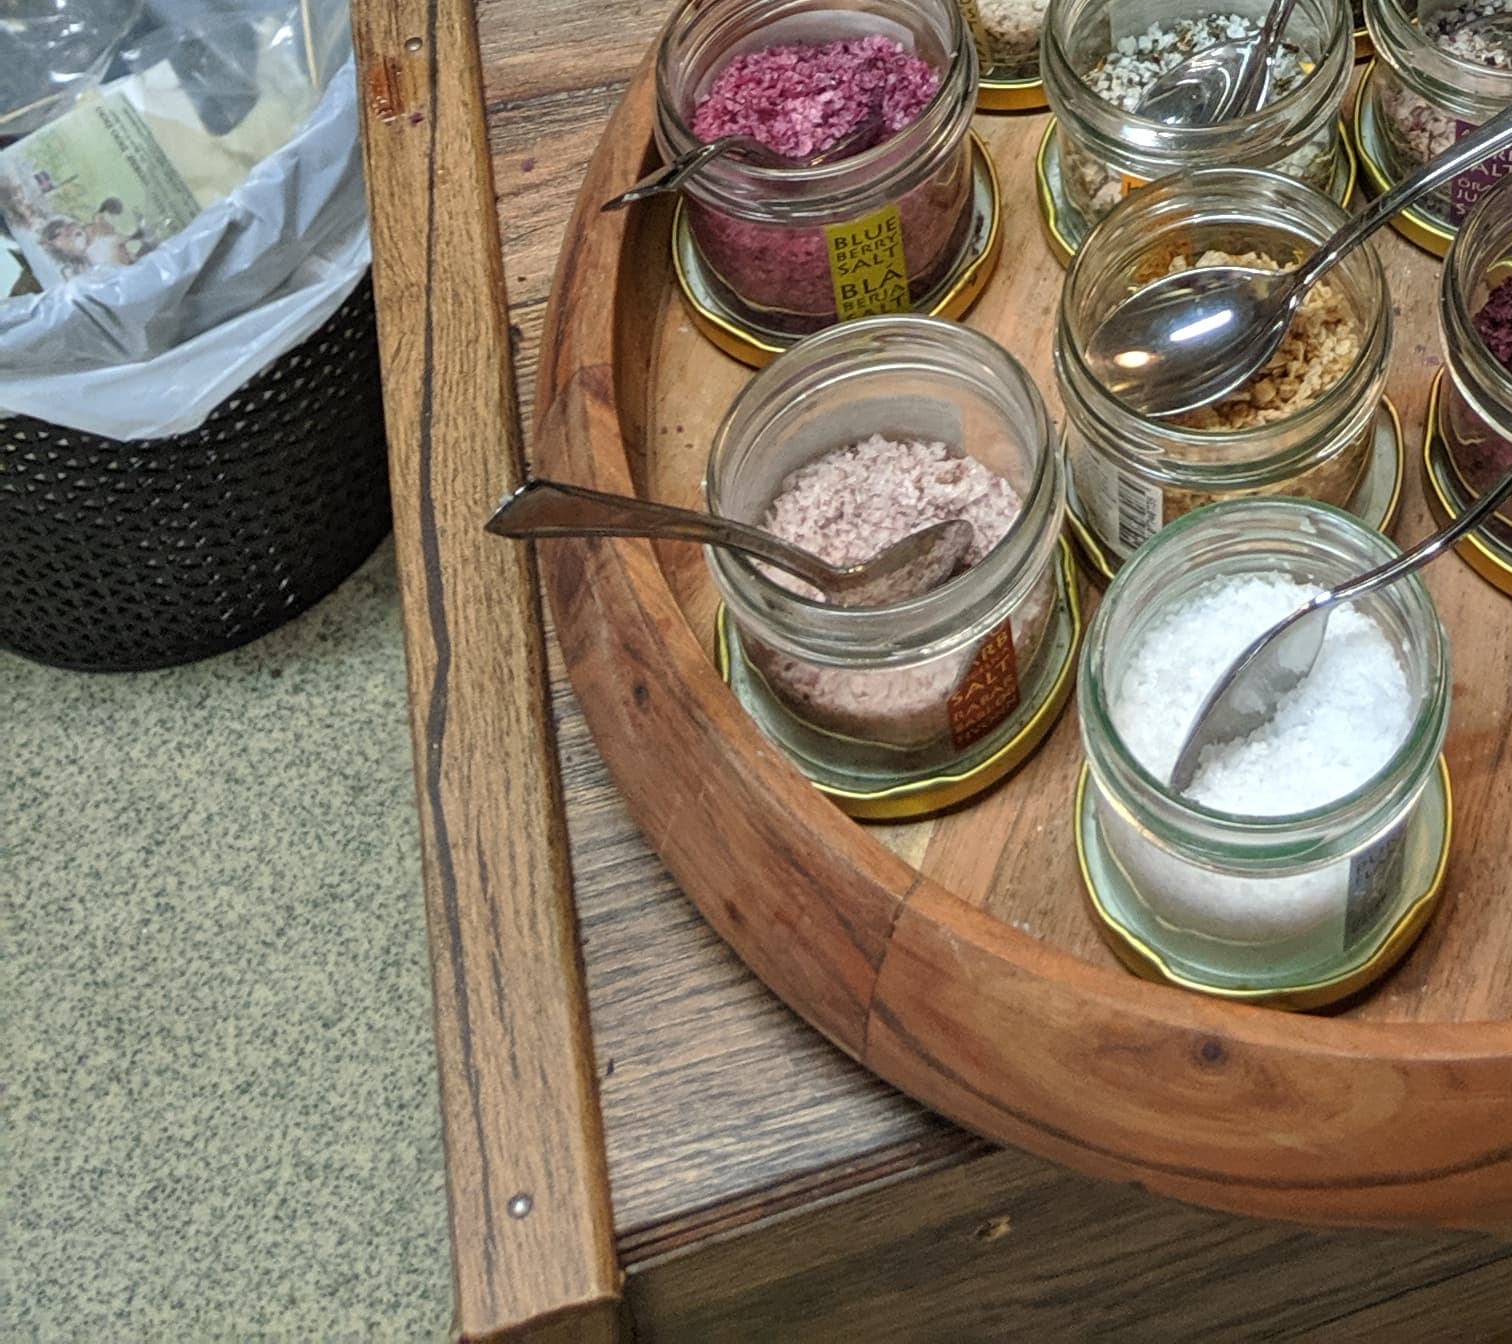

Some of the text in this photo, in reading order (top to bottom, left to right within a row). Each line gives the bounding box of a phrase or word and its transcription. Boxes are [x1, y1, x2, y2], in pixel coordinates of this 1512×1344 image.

[835, 216, 896, 250] BLUE
[837, 231, 897, 262] BERRY
[838, 243, 898, 276] SALT
[841, 263, 902, 300] BLÁ
[843, 284, 905, 312] BERJA
[951, 655, 1009, 706] SALT
